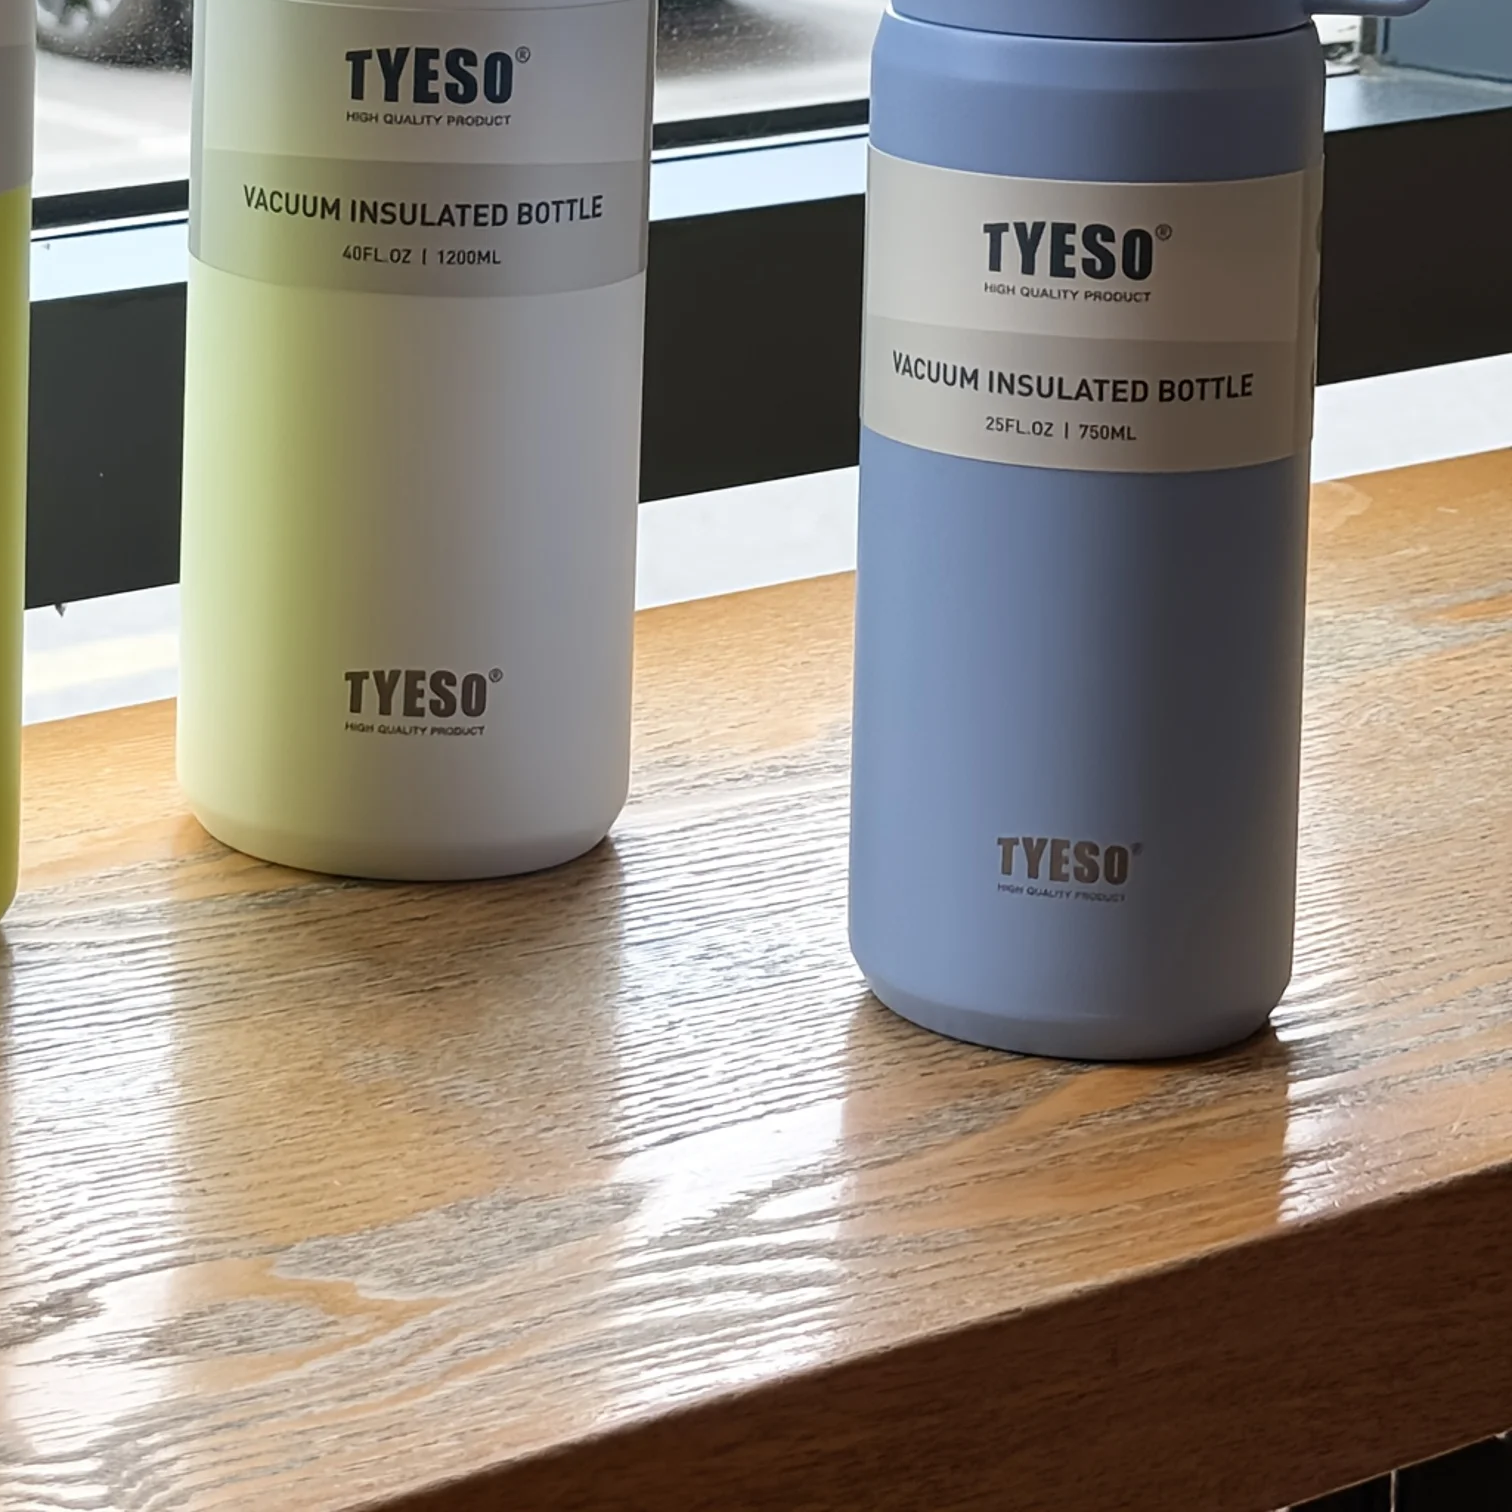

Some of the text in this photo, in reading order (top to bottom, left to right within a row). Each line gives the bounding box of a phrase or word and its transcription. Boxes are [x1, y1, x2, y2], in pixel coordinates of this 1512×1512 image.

[346, 110, 512, 127] HIGH QUALITY PRODUCT
[243, 184, 604, 228] VACUUM INSULATED BOTTLE
[437, 248, 502, 265] 1200ML
[984, 282, 1152, 303] HIGH QUALITY PRODUCT
[892, 349, 1254, 403] VACUUM INSULATED BOTTLE
[1079, 423, 1137, 440] 750ML
[345, 720, 485, 737] HIGH QUALITY PRODUCT
